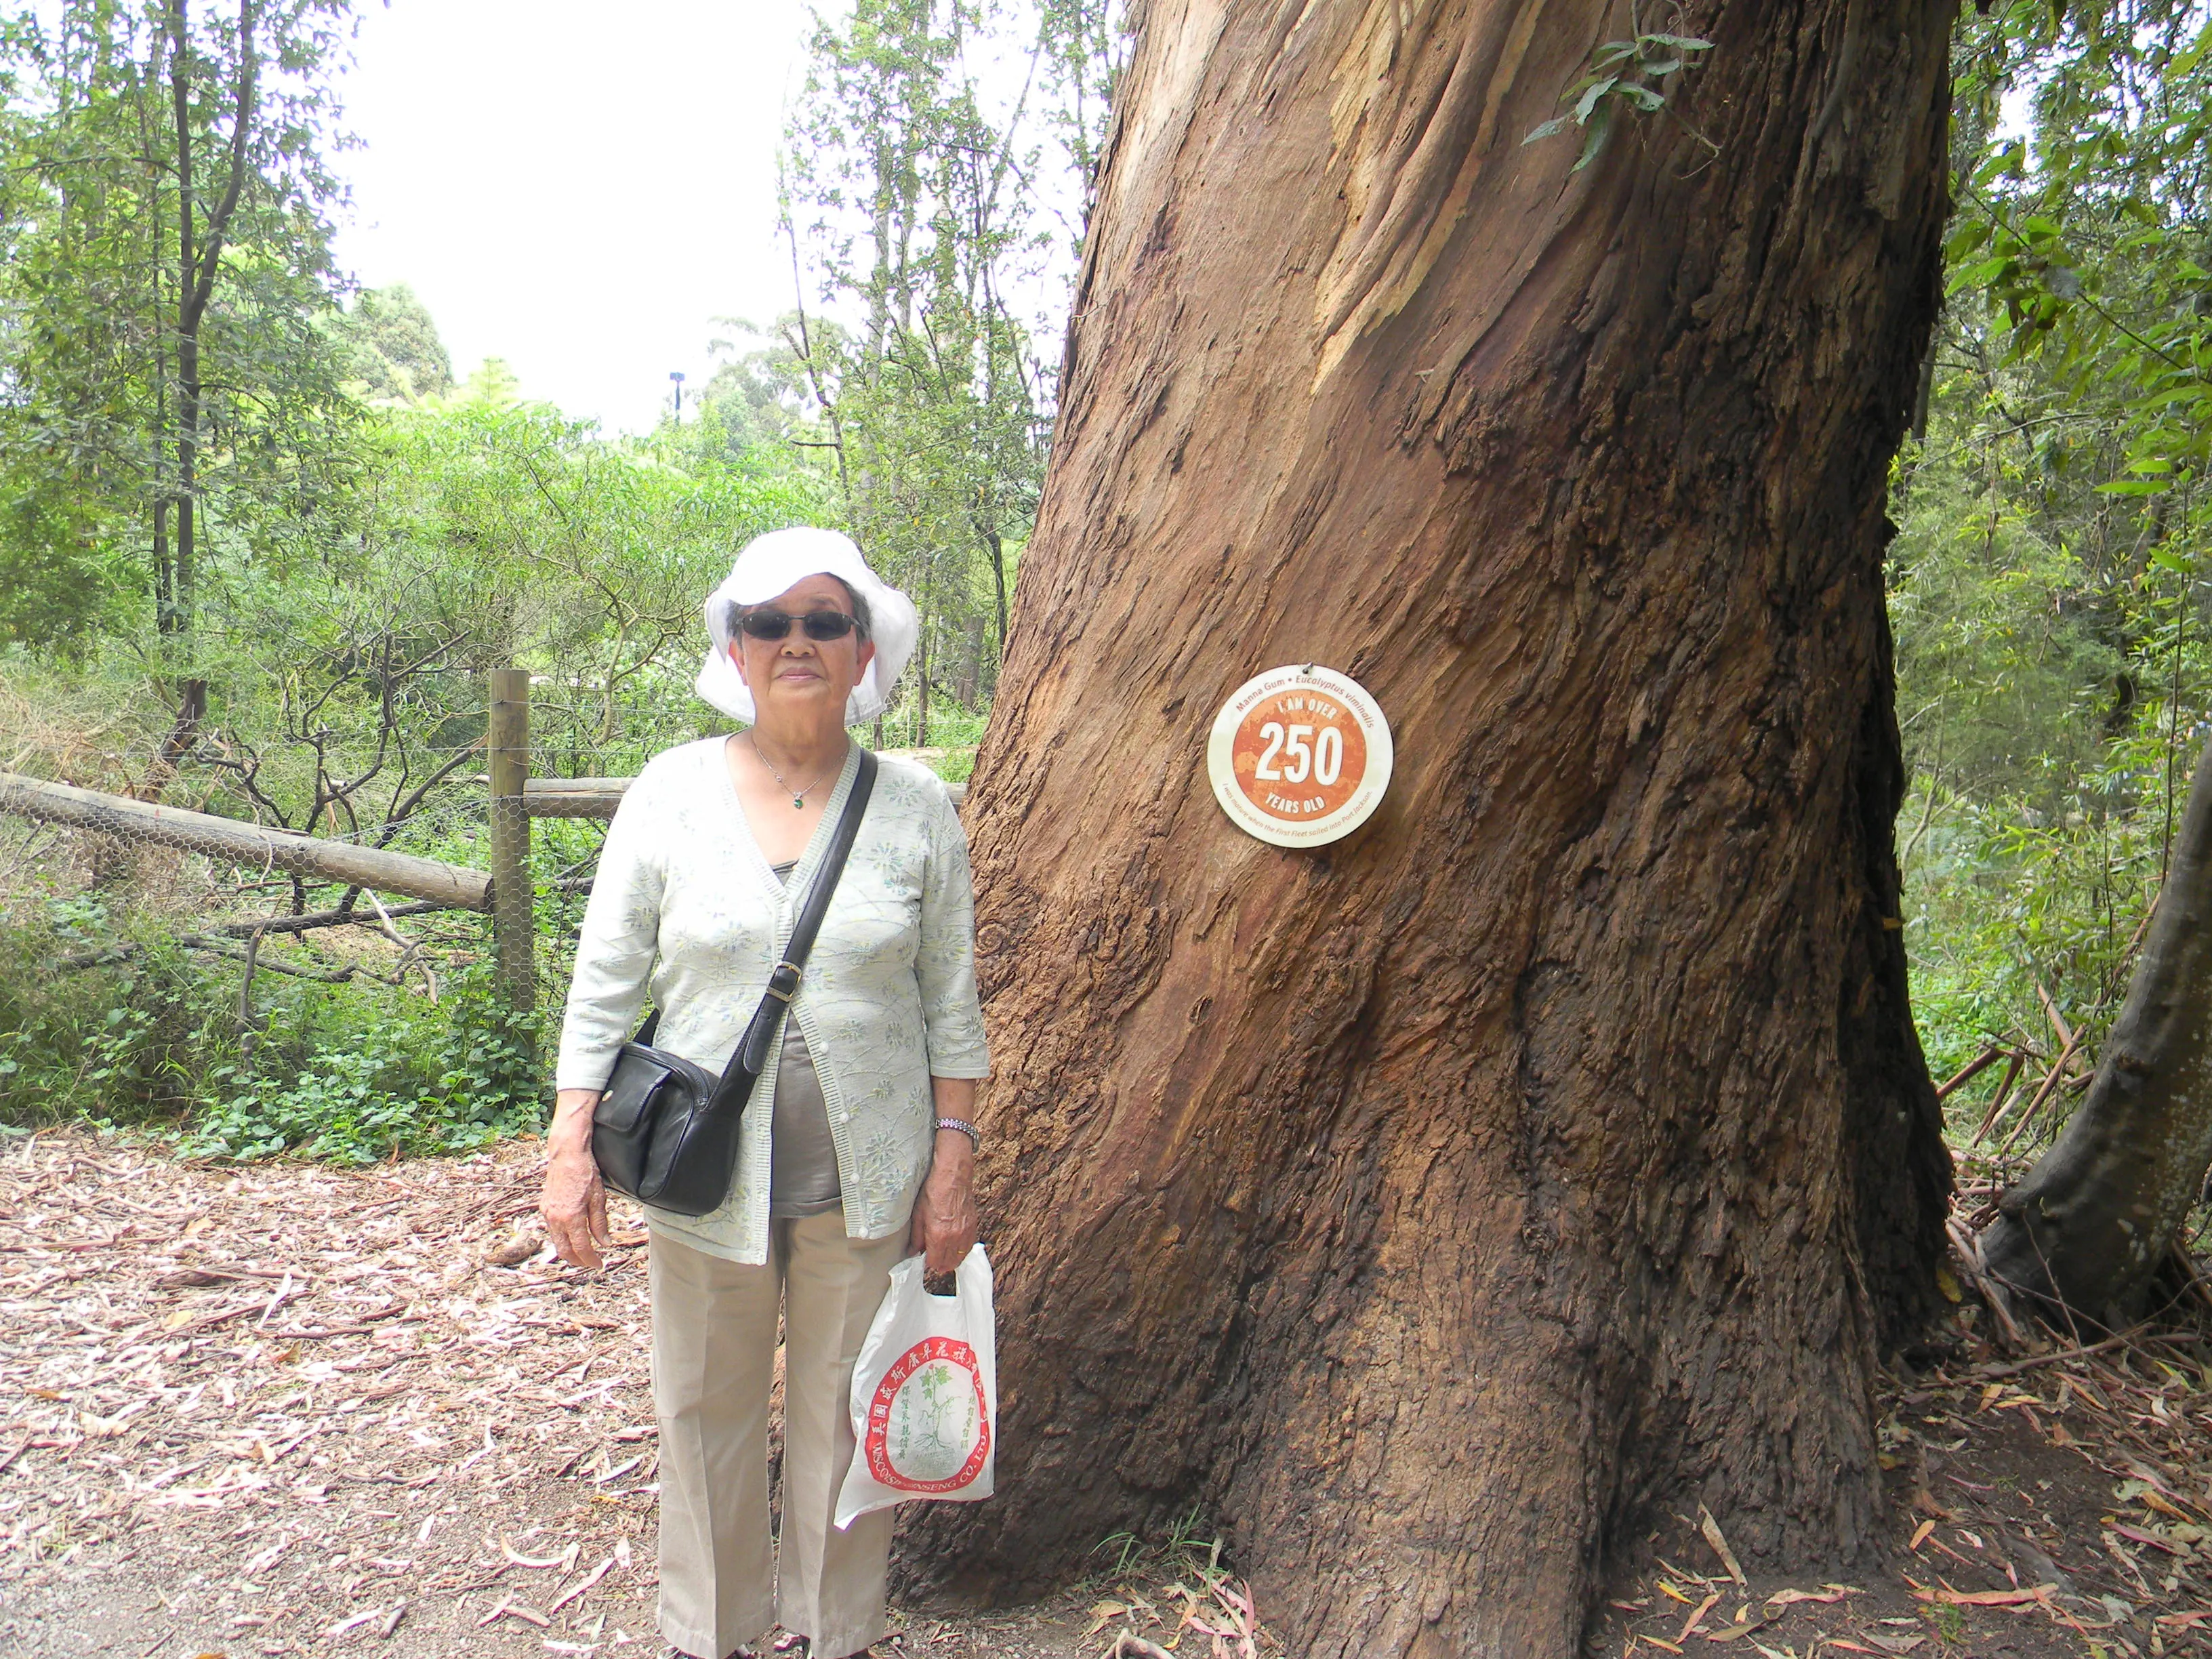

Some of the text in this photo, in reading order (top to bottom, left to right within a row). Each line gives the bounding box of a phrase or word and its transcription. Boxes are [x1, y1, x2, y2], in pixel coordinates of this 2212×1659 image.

[1235, 675, 1374, 729] Manna Gum Eucalyptus viminalis
[1277, 697, 1339, 720] I AM OVER
[1254, 721, 1344, 786] 250
[1224, 787, 1233, 800] was
[1230, 798, 1248, 818] mature
[1248, 815, 1265, 829] when
[1264, 824, 1275, 833] the
[1308, 826, 1329, 836] sailed
[1329, 821, 1343, 830] into
[1341, 812, 1355, 823] Port
[1265, 792, 1326, 814] YEARS OLD
[960, 1464, 977, 1483] CO.
